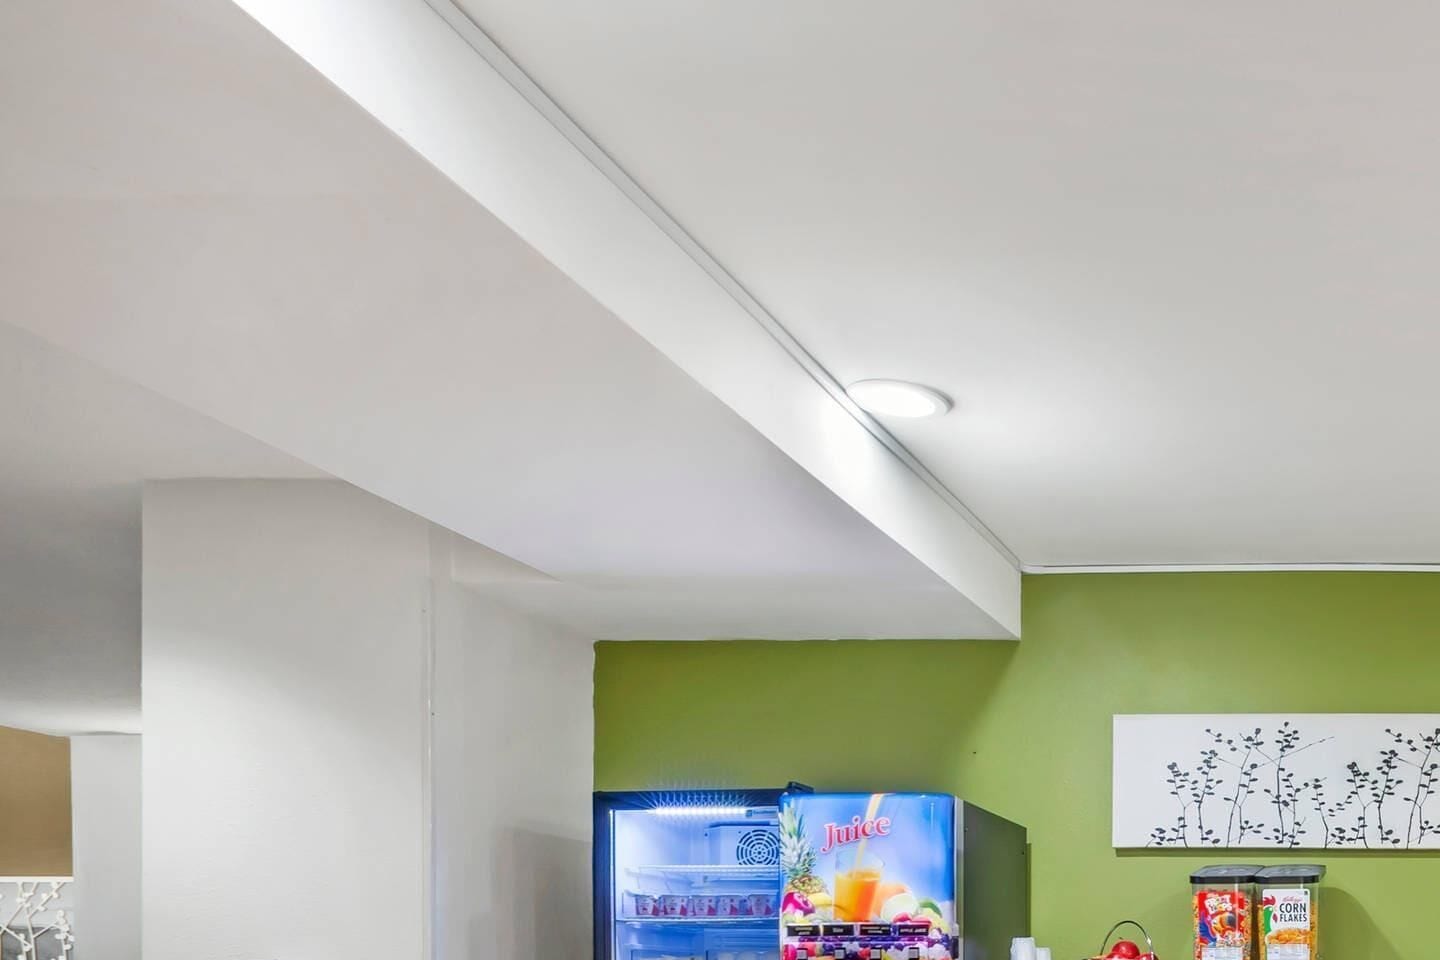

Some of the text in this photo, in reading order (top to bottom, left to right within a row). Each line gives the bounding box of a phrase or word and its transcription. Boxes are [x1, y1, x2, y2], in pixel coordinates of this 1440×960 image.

[820, 815, 892, 854] Juice
[1279, 902, 1307, 913] CORN
[1279, 913, 1308, 922] FLAKES
